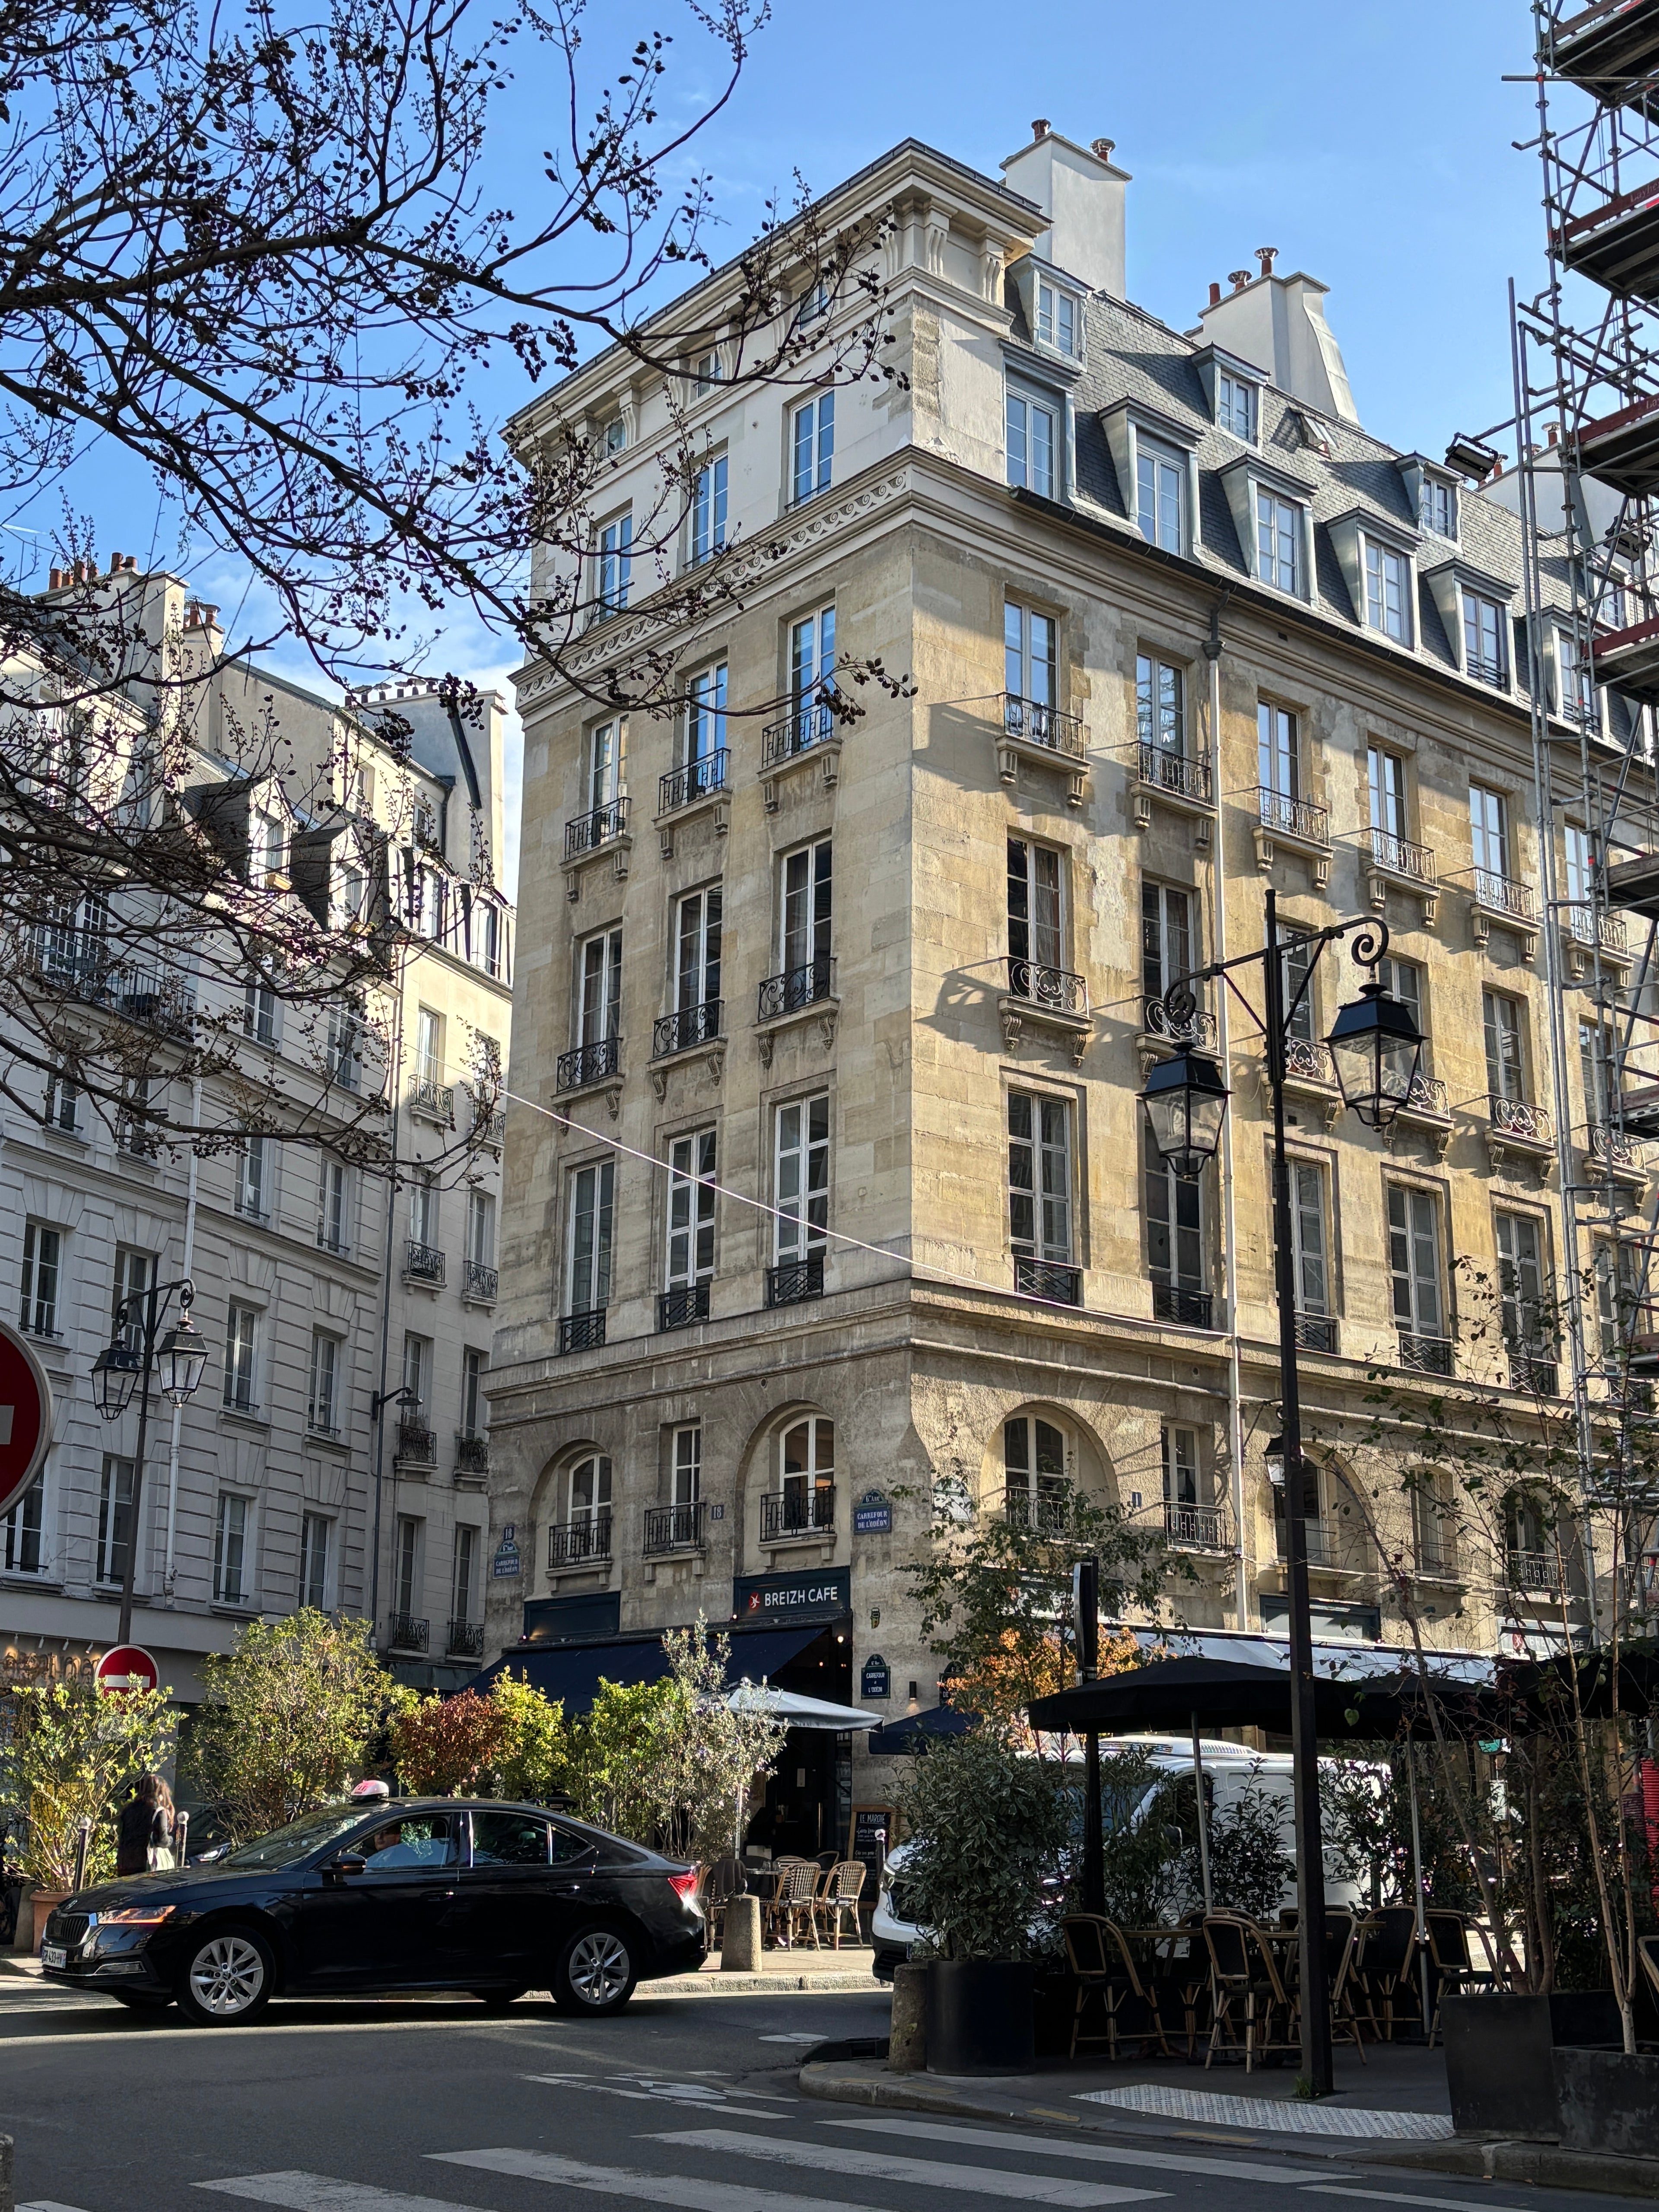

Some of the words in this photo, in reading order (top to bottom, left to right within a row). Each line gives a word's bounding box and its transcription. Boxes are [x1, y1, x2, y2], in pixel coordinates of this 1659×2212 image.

[714, 1506, 721, 1519] 18
[857, 1511, 888, 1519] CARREFOUR
[866, 1519, 887, 1528] L'ODÉON
[505, 1528, 512, 1539] 18
[765, 1589, 805, 1606] BREIZH
[808, 1586, 838, 1602] CAFE
[860, 1814, 865, 1822] LE
[867, 1813, 886, 1824] MARCHÉ
